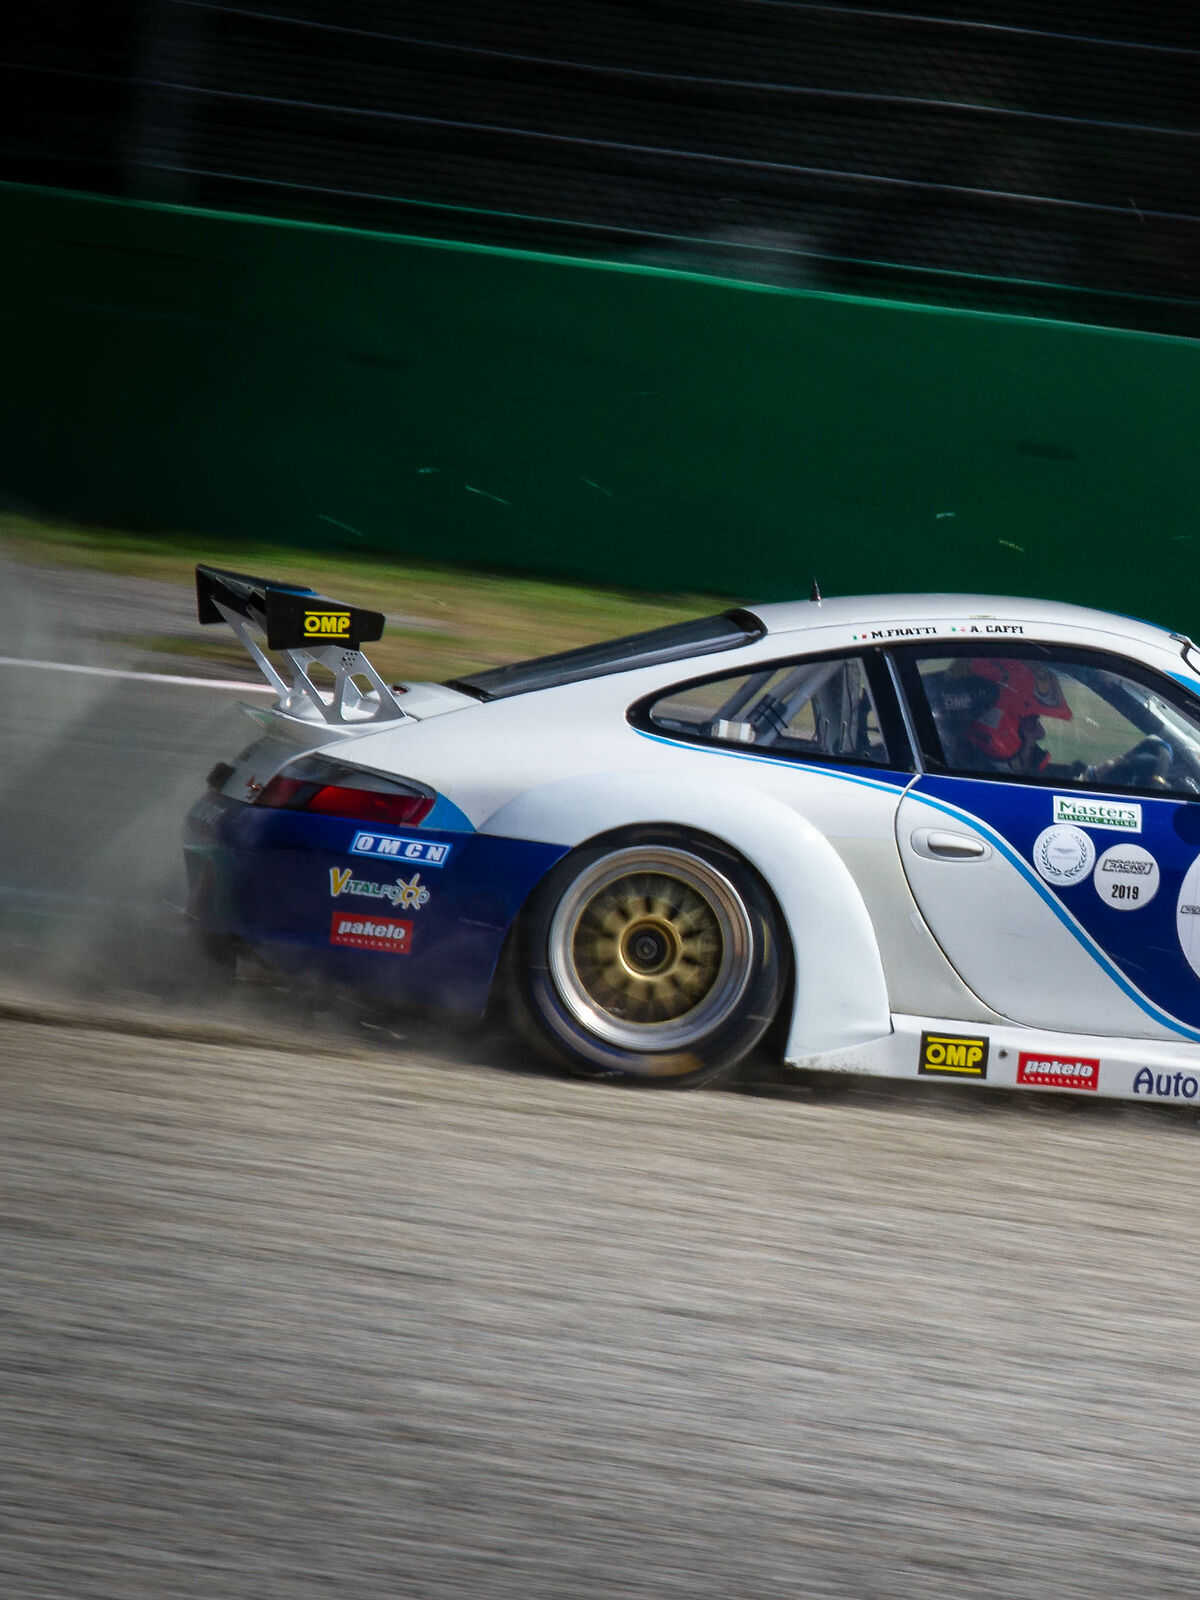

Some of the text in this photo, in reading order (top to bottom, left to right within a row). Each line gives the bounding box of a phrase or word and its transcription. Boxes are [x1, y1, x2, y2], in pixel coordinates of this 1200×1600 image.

[304, 616, 350, 633] OMP
[970, 625, 983, 634] A.
[1060, 801, 1135, 819] Masters
[1058, 813, 1136, 828] HISTORIC RACING
[356, 836, 444, 861] OMCN
[1109, 862, 1146, 872] RACING
[1112, 884, 1139, 900] 2019
[338, 920, 406, 940] pakelo
[926, 1043, 983, 1067] OMP
[1024, 1059, 1093, 1077] pakelo
